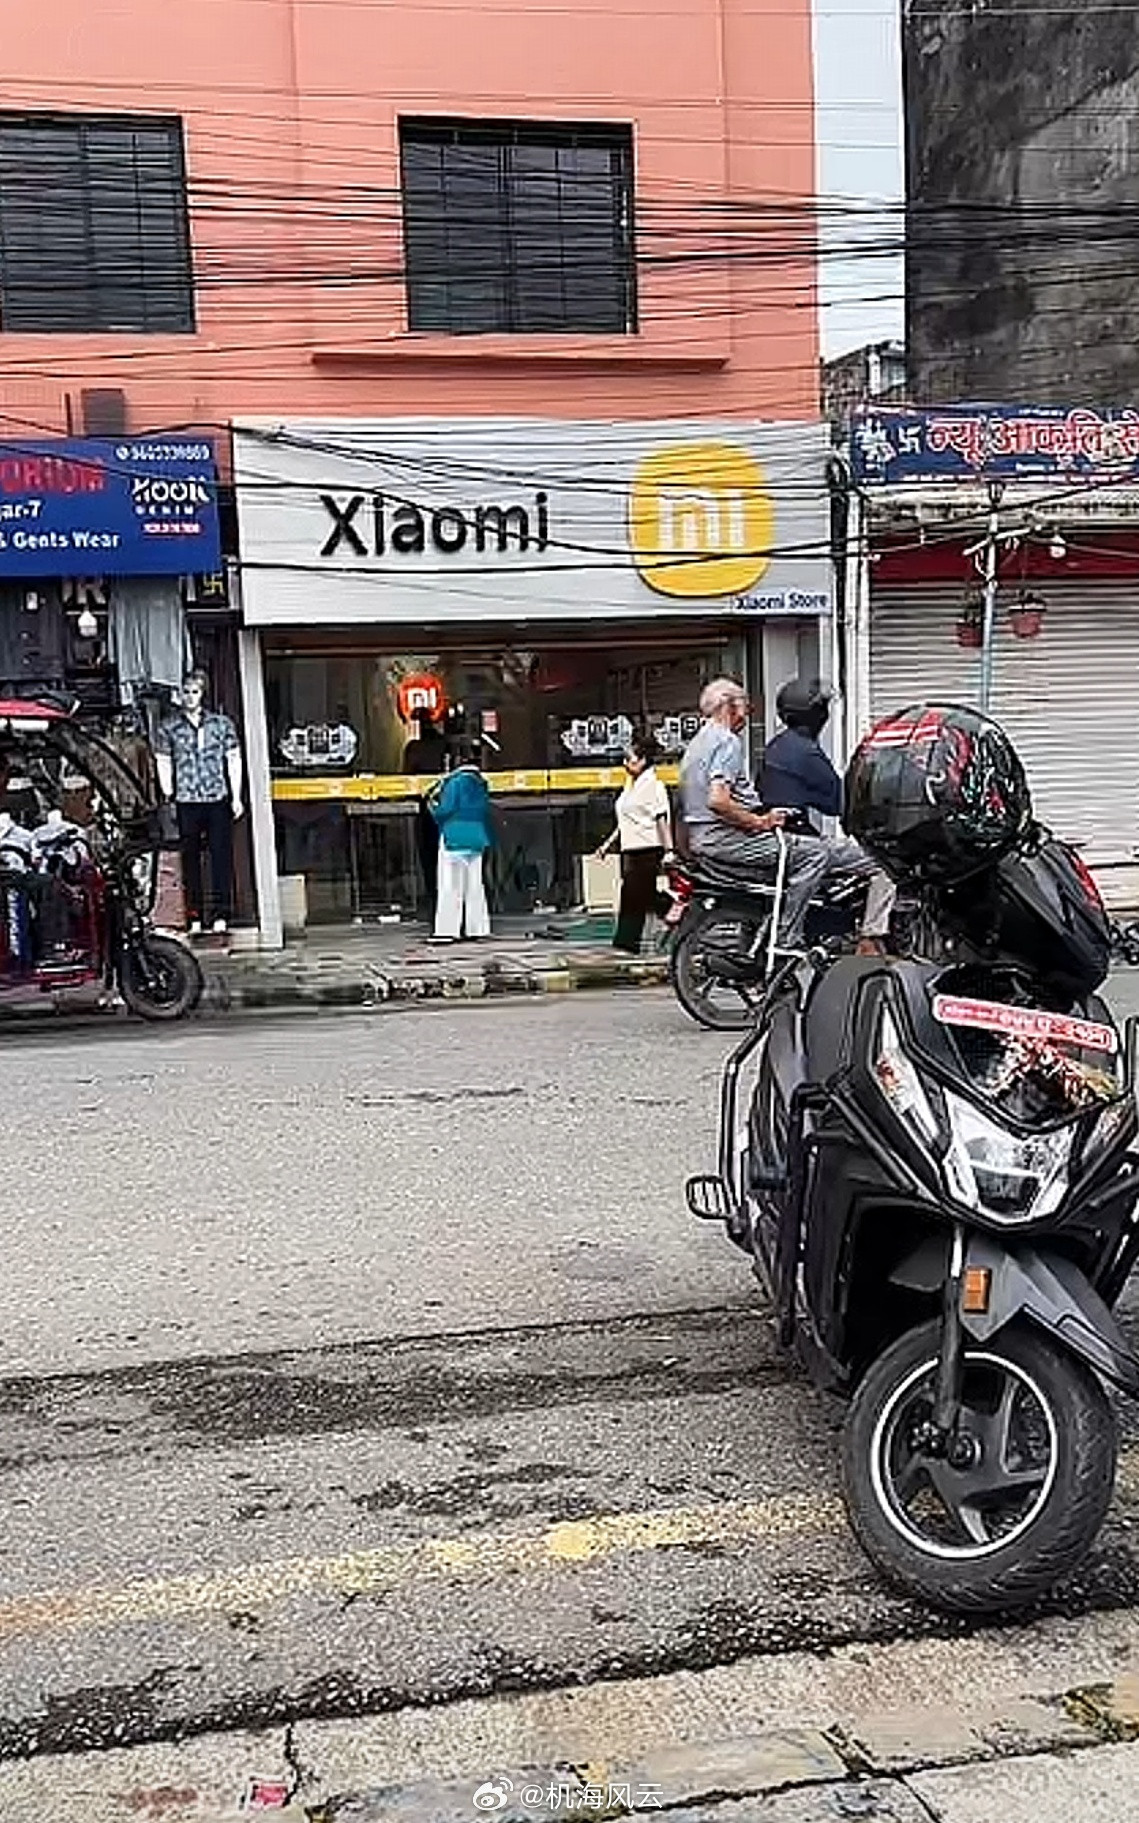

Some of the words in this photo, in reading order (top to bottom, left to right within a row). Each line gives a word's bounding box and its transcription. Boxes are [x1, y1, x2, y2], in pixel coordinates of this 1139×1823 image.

[319, 491, 548, 556] Xiaomi
[13, 531, 68, 549] Gents
[72, 530, 120, 548] Wear
[735, 593, 785, 609] Xiaomi
[789, 592, 827, 609] Store
